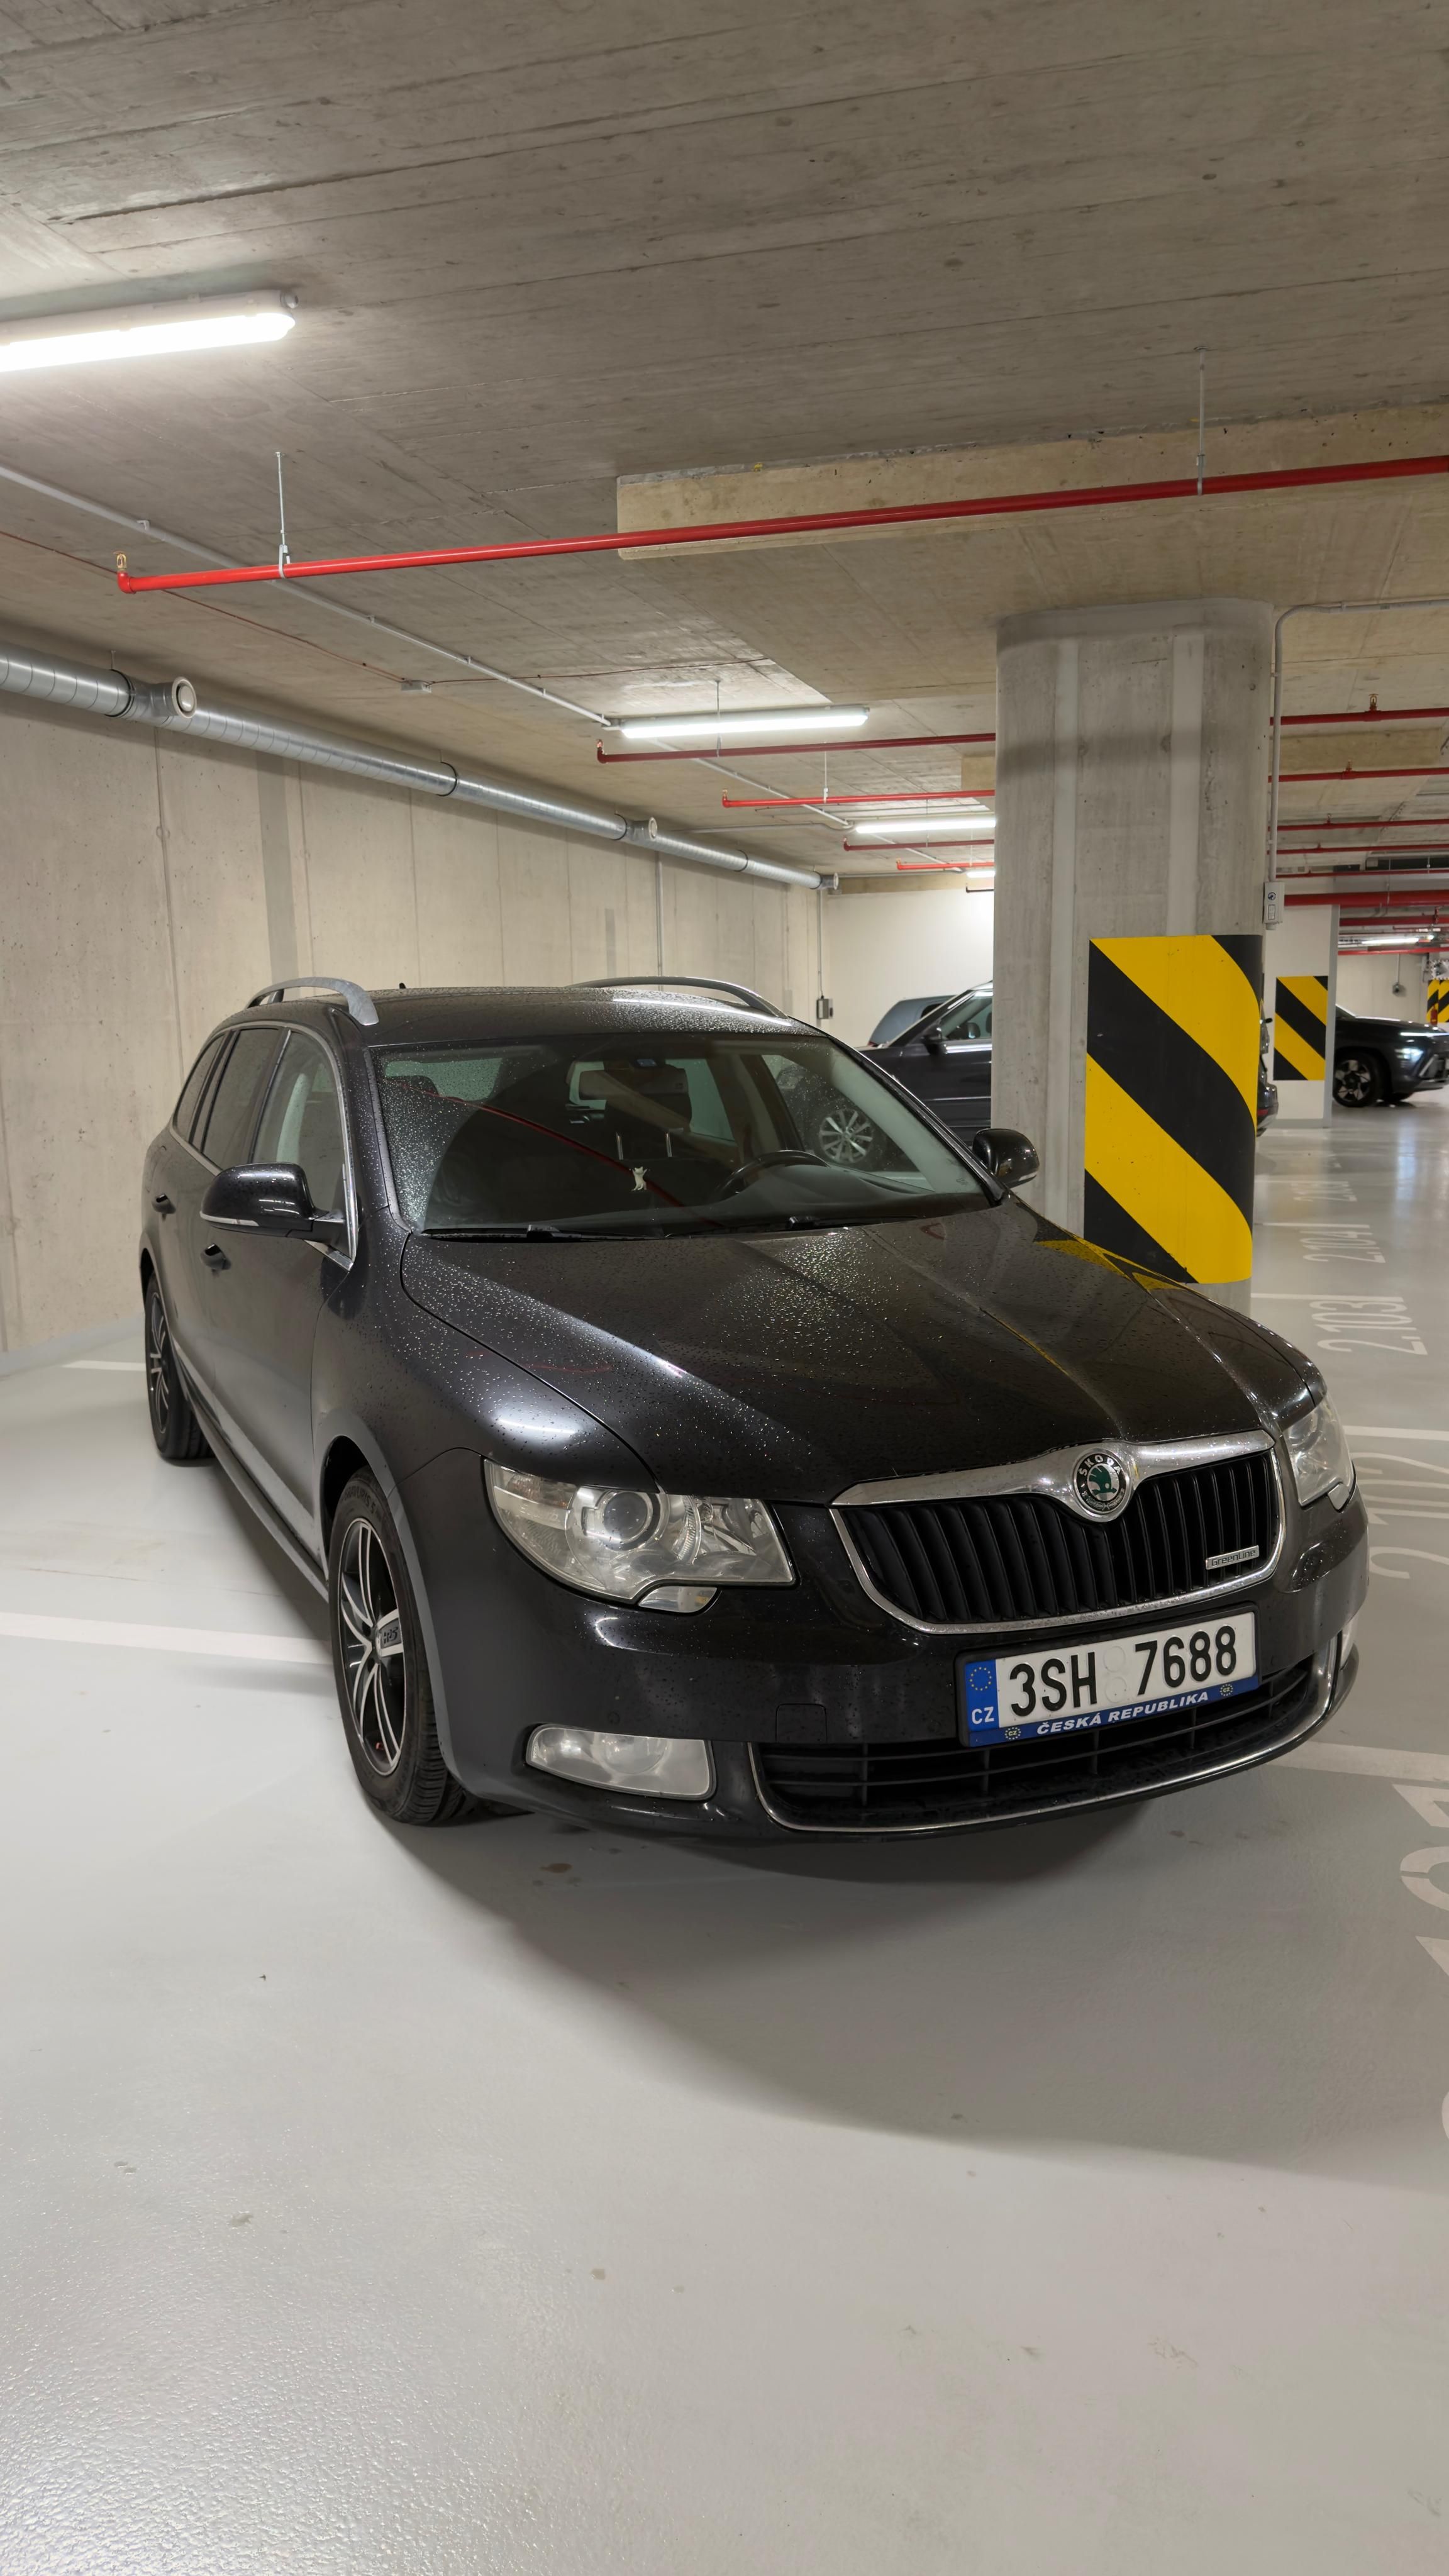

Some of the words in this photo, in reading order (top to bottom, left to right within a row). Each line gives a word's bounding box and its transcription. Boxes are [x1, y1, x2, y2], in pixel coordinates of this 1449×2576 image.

[1299, 1230, 1386, 1263] 2.104
[1309, 1300, 1428, 1356] 2.103
[1211, 1550, 1256, 1566] GreenLine
[1009, 1652, 1097, 1717] 3SH
[1135, 1626, 1236, 1696] 7688
[972, 1706, 994, 1724] CZ
[1037, 1712, 1102, 1735] ČESKÁ
[1108, 1691, 1208, 1721] REPUBLIKA
